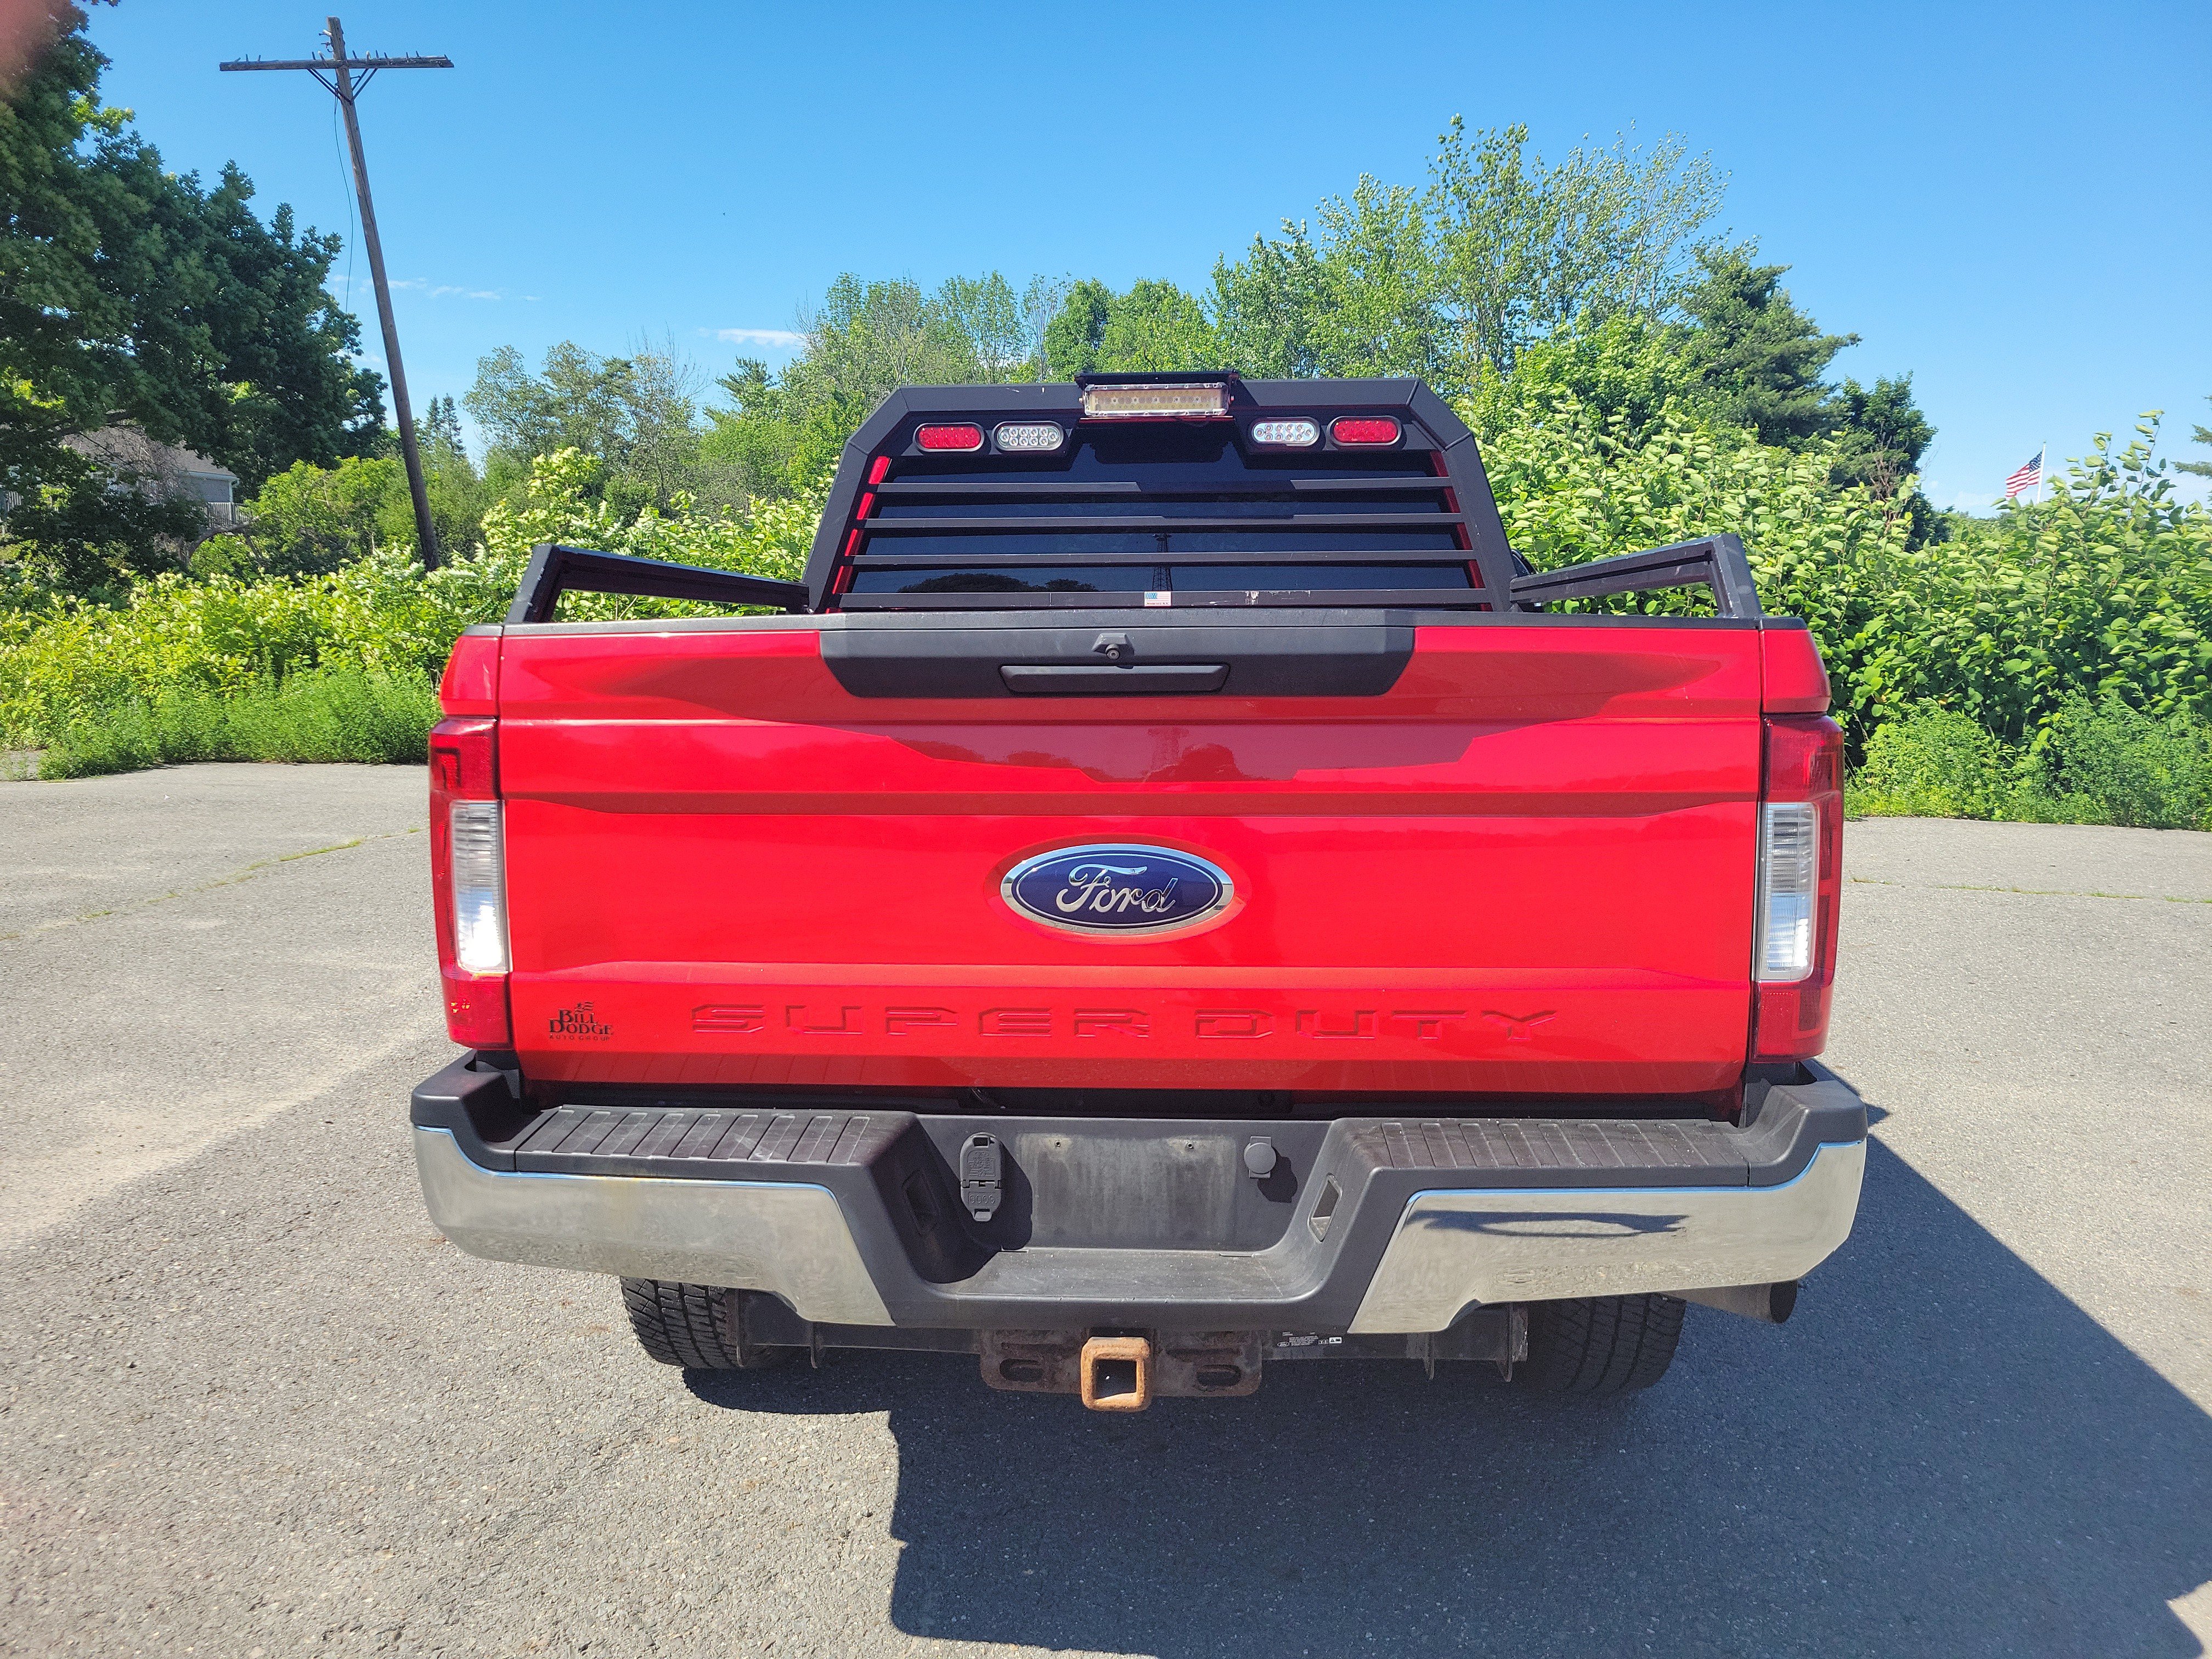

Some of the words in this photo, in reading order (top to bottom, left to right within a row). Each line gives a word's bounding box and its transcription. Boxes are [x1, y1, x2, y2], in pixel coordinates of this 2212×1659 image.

[1056, 864, 1178, 913] Ford
[548, 1019, 614, 1035] DODGE
[558, 1009, 598, 1023] BILL
[691, 1004, 1150, 1037] SUPER
[1195, 1008, 1557, 1040] DUTY
